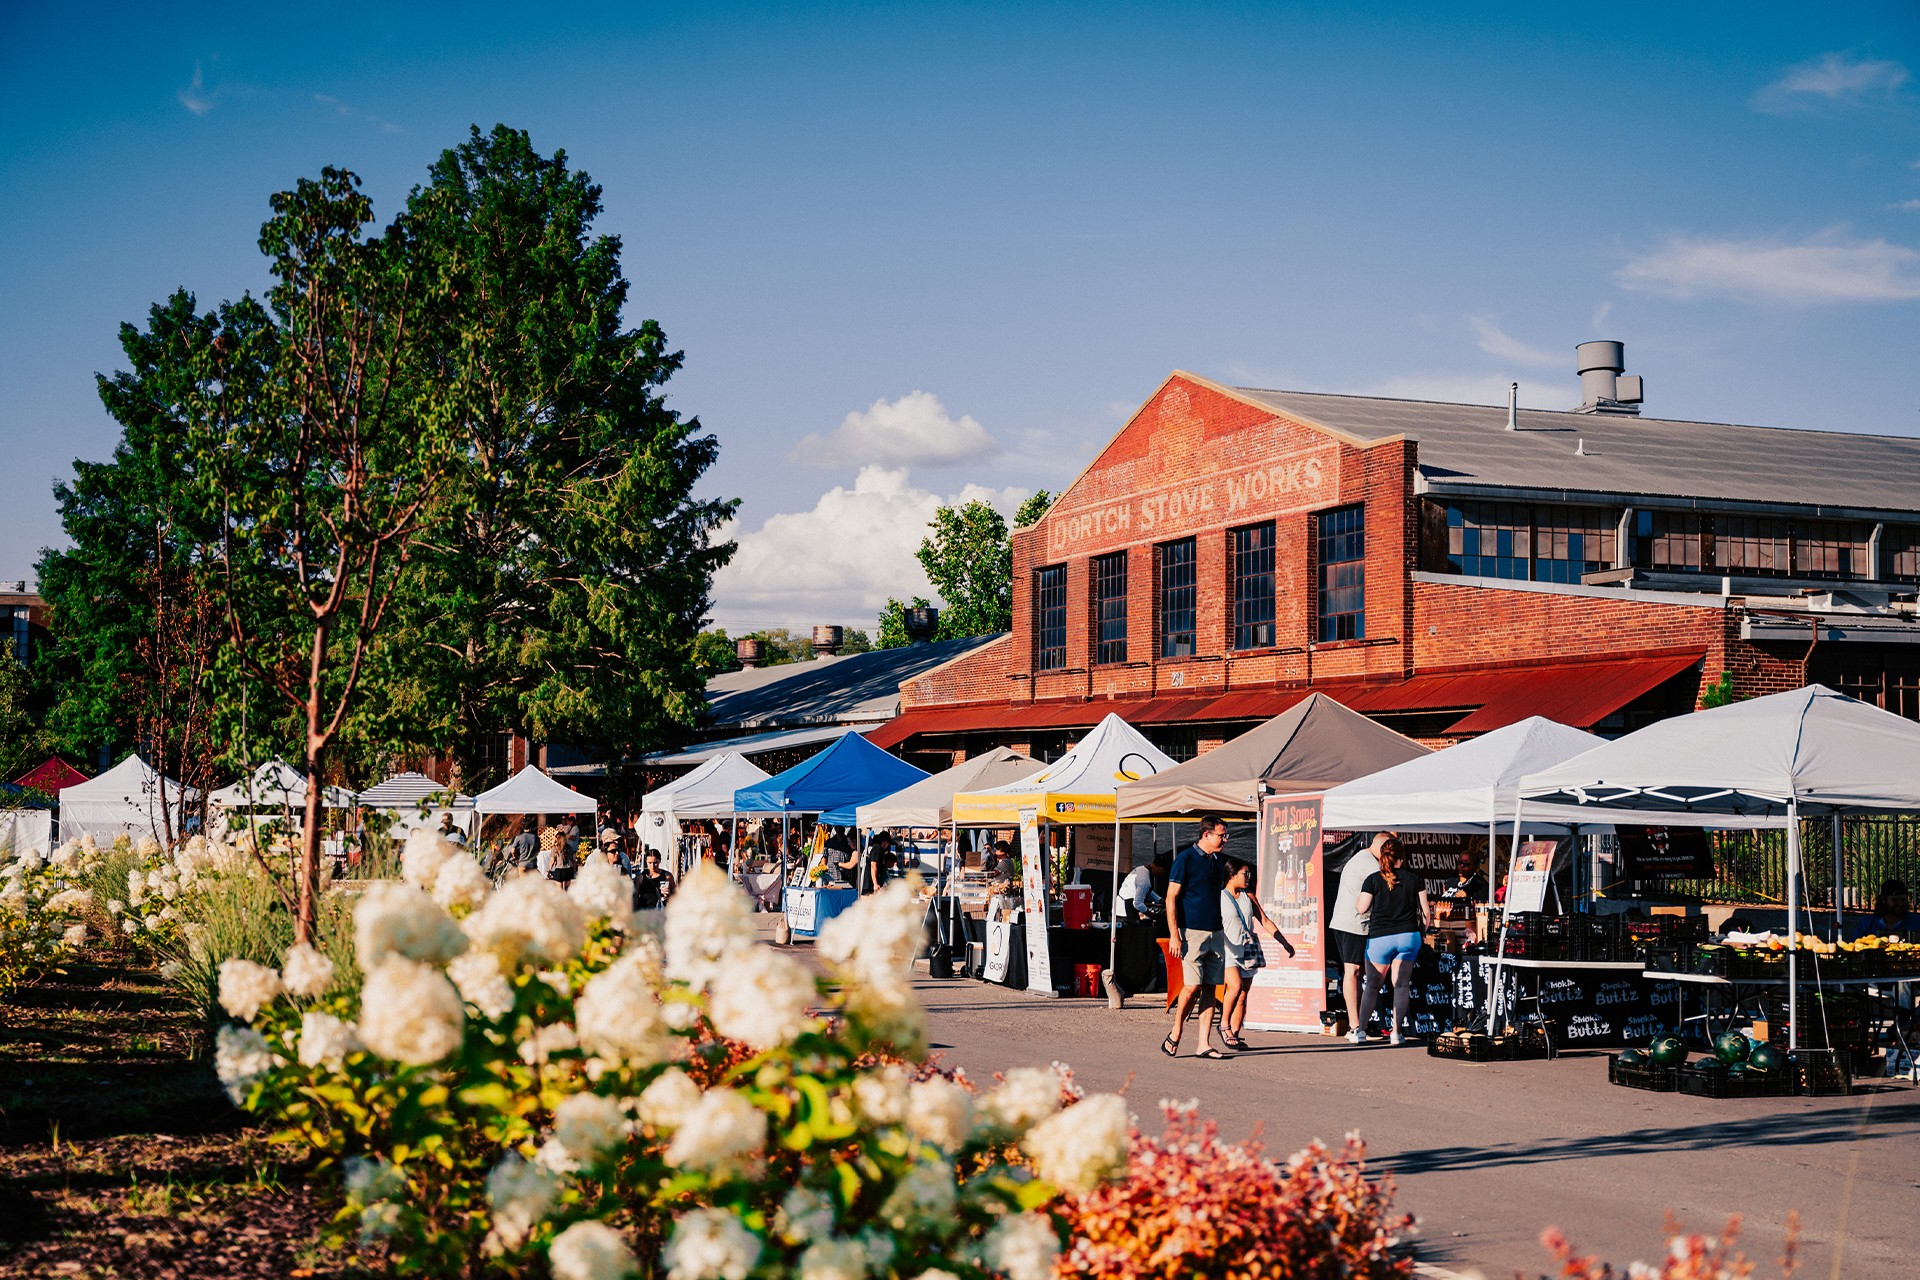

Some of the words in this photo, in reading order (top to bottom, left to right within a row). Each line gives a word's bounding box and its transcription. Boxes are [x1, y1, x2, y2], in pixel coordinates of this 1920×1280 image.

[1055, 503, 1130, 549] DORTCH
[1141, 484, 1214, 531] STOVE
[1226, 458, 1321, 513] WORKS
[1273, 806, 1288, 825] Put
[1290, 806, 1315, 824] Some
[1293, 832, 1304, 847] on
[1306, 830, 1311, 846] it
[1420, 832, 1461, 845] PEANUTS
[1540, 988, 1583, 1003] Buttz
[1596, 990, 1638, 1005] Buttz
[1568, 1022, 1611, 1038] Buttz
